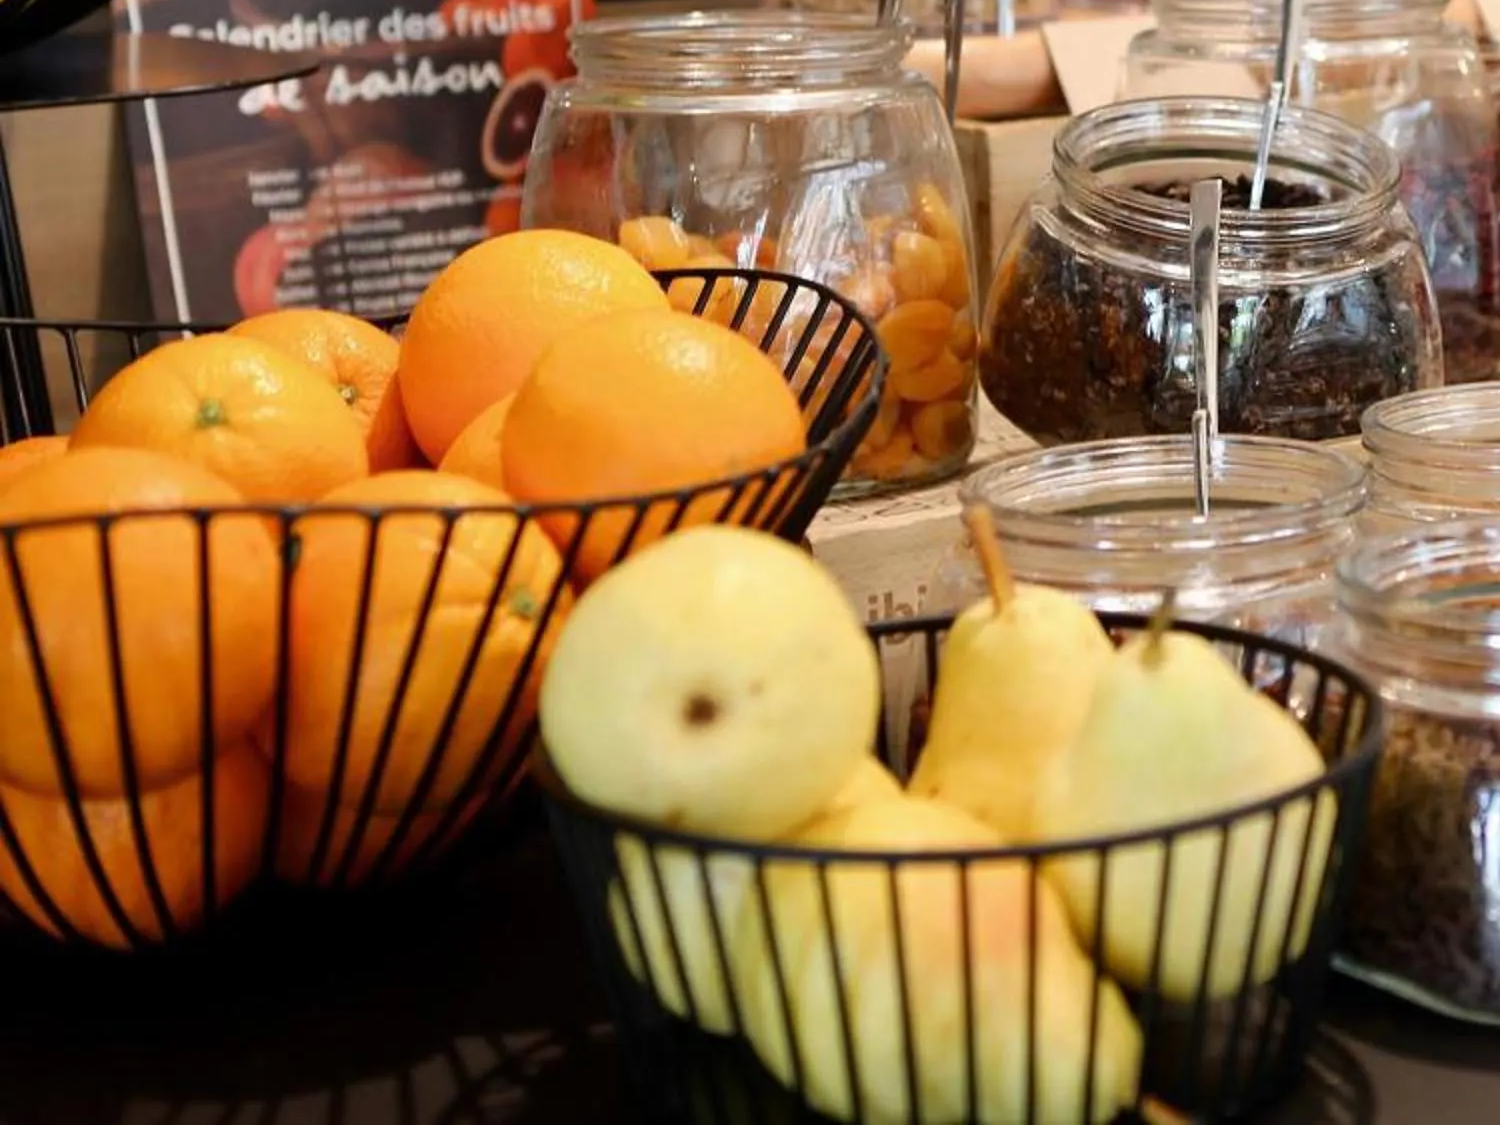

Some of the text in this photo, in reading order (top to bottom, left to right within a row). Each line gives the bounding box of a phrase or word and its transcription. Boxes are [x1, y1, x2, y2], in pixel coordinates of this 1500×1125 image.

[169, 0, 555, 52] lendrier des fruits
[325, 52, 505, 105] saison
